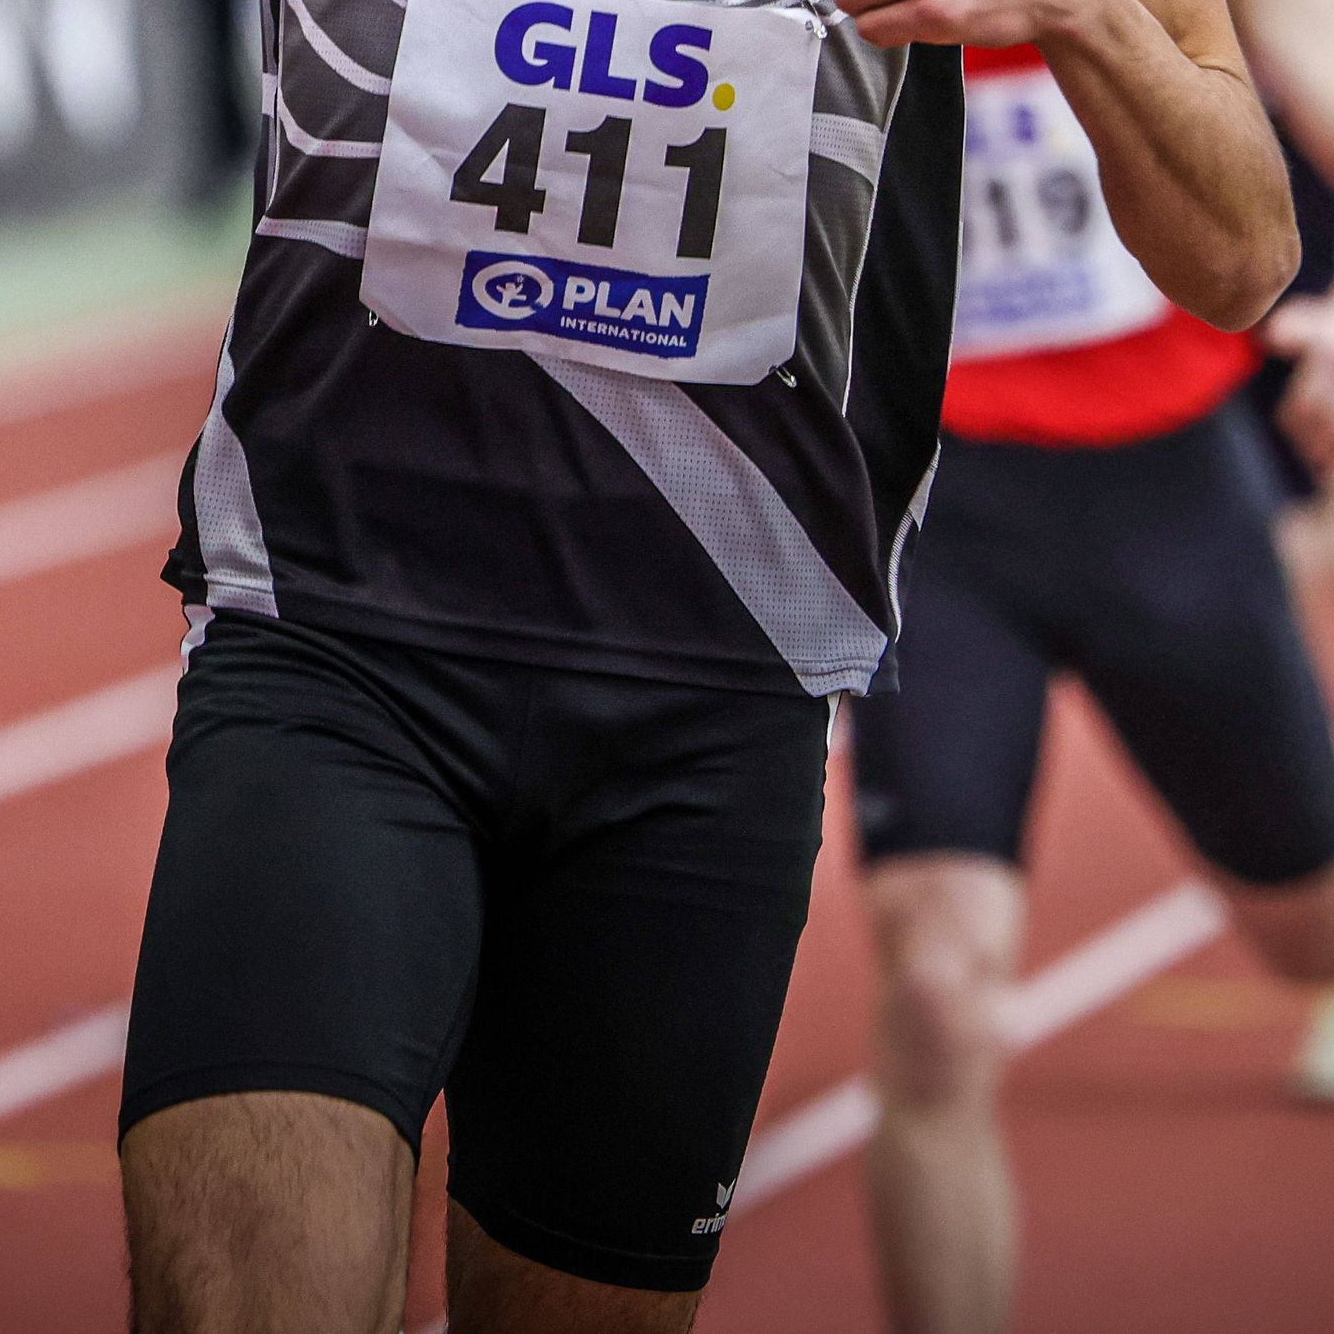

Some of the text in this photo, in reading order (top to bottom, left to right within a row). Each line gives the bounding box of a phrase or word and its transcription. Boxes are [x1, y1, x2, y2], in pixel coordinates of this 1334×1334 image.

[449, 102, 728, 260] 411
[964, 169, 1093, 252] 19
[560, 315, 688, 349] INTERNATIONAL
[563, 276, 696, 329] PLAN
